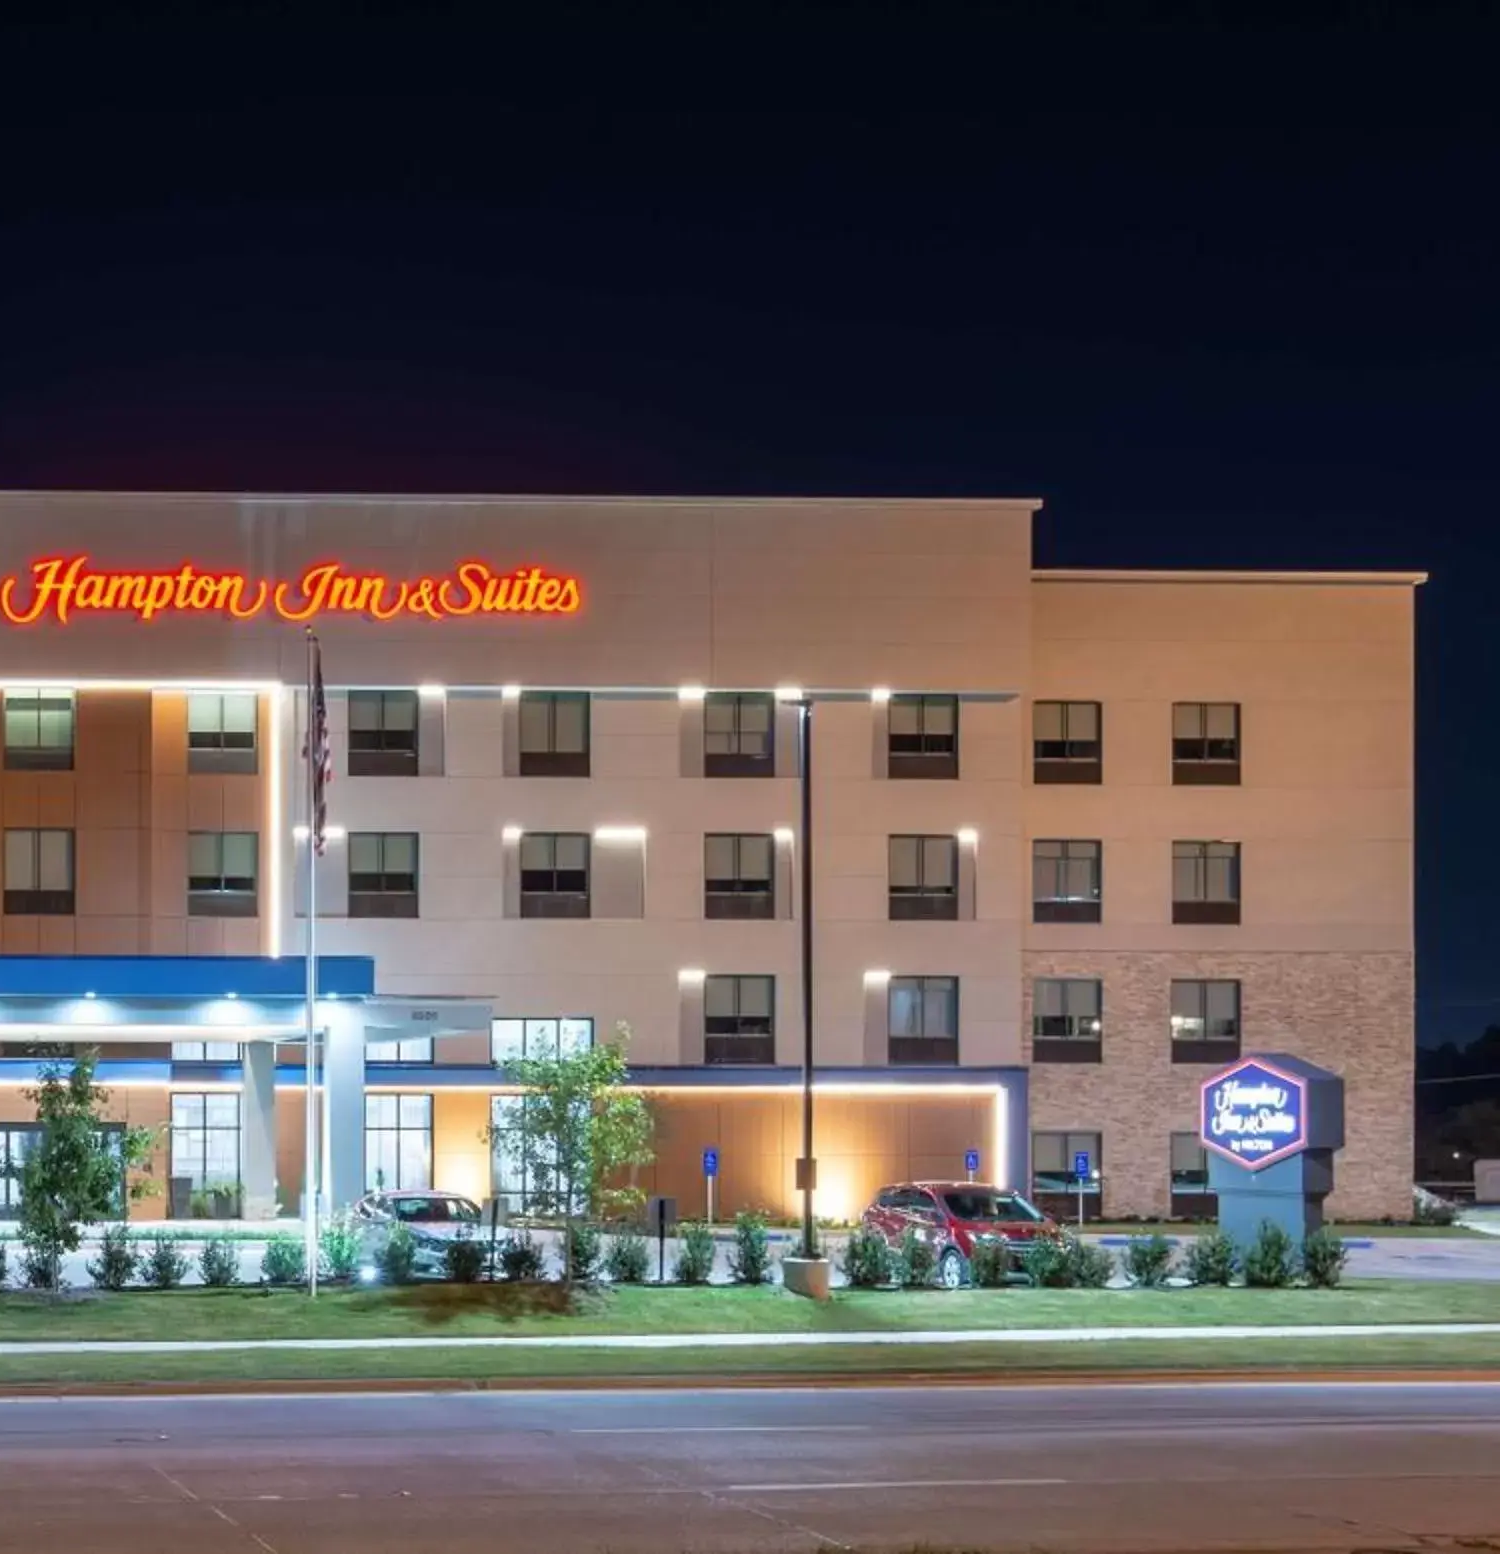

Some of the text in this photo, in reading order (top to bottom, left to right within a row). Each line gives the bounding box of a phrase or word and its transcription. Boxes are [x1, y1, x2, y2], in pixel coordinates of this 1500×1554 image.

[1, 555, 581, 625] Hampton Inn & Suites
[1214, 1080, 1288, 1110] Hampton
